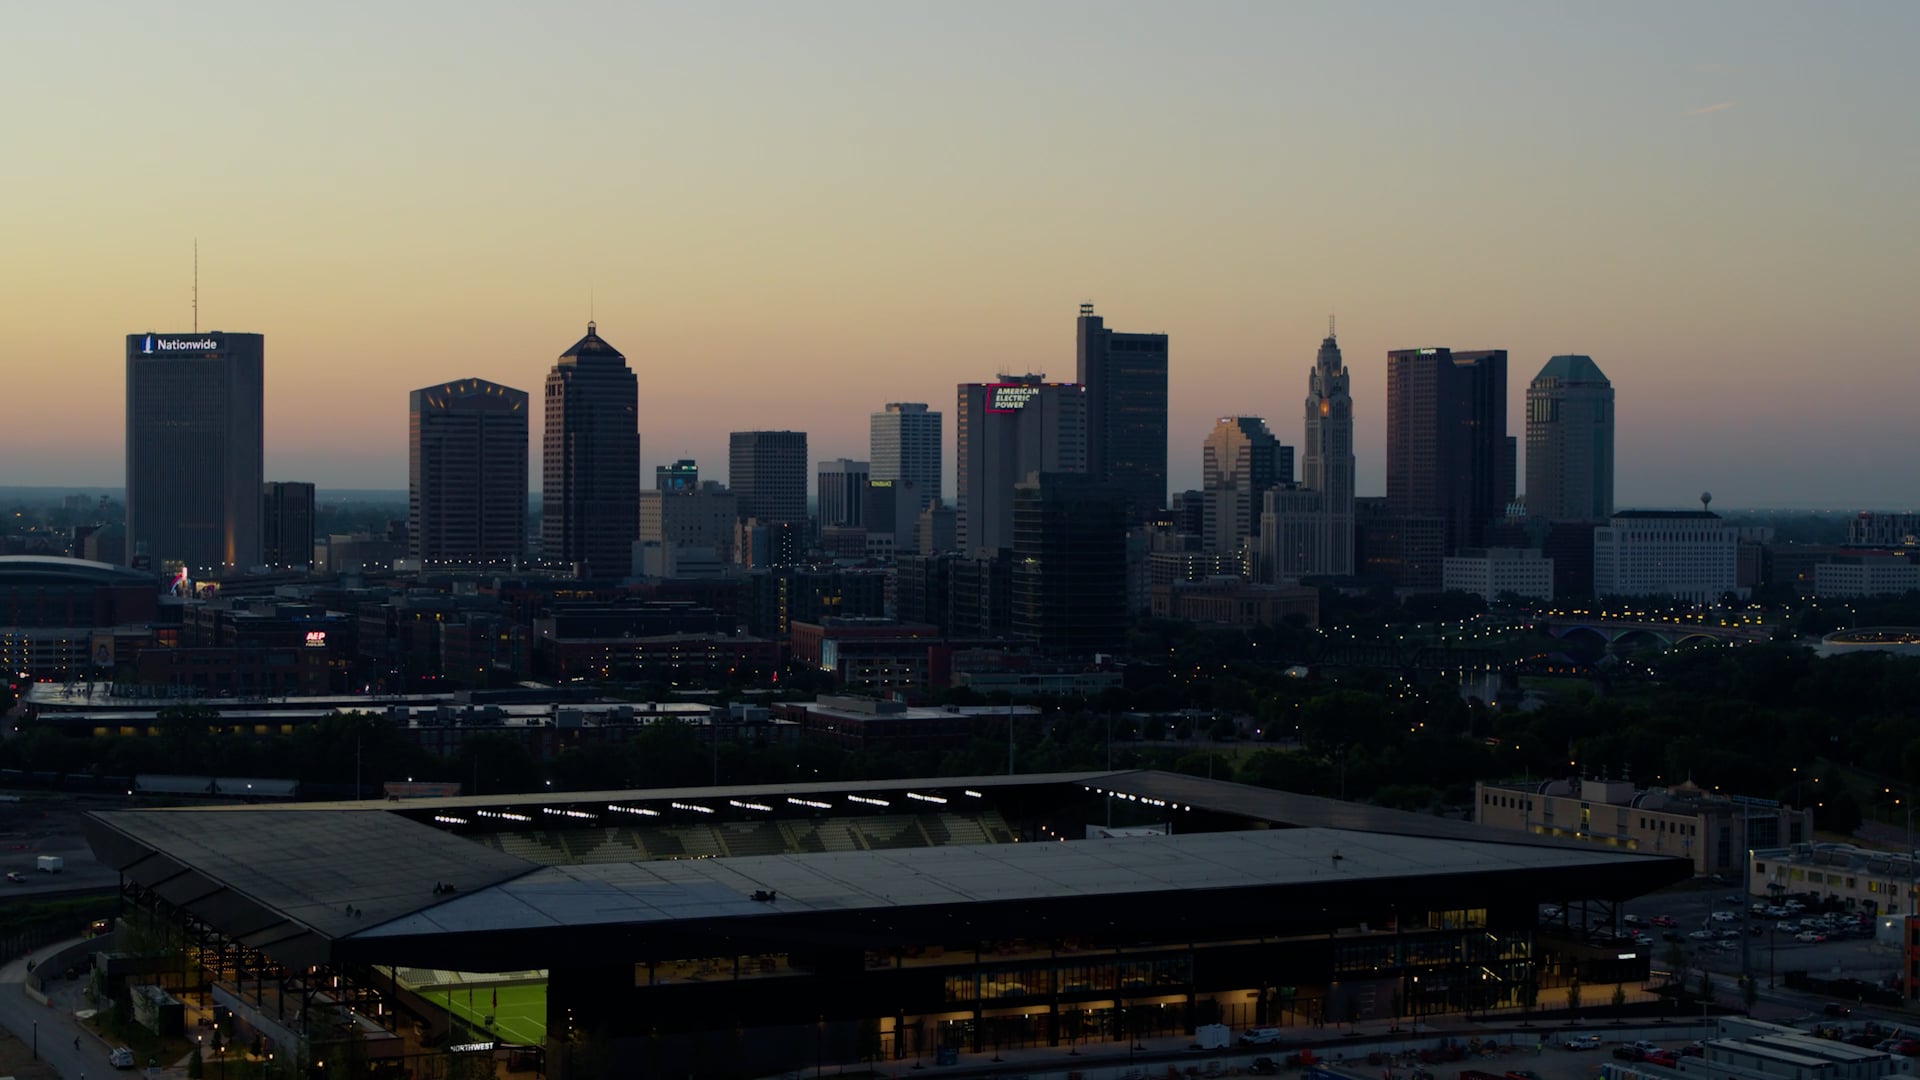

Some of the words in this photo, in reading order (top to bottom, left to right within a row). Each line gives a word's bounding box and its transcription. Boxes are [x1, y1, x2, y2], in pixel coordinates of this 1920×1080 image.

[157, 339, 217, 350] Nationwide
[306, 631, 326, 640] AEP
[450, 1042, 494, 1052] NORTHWEST
